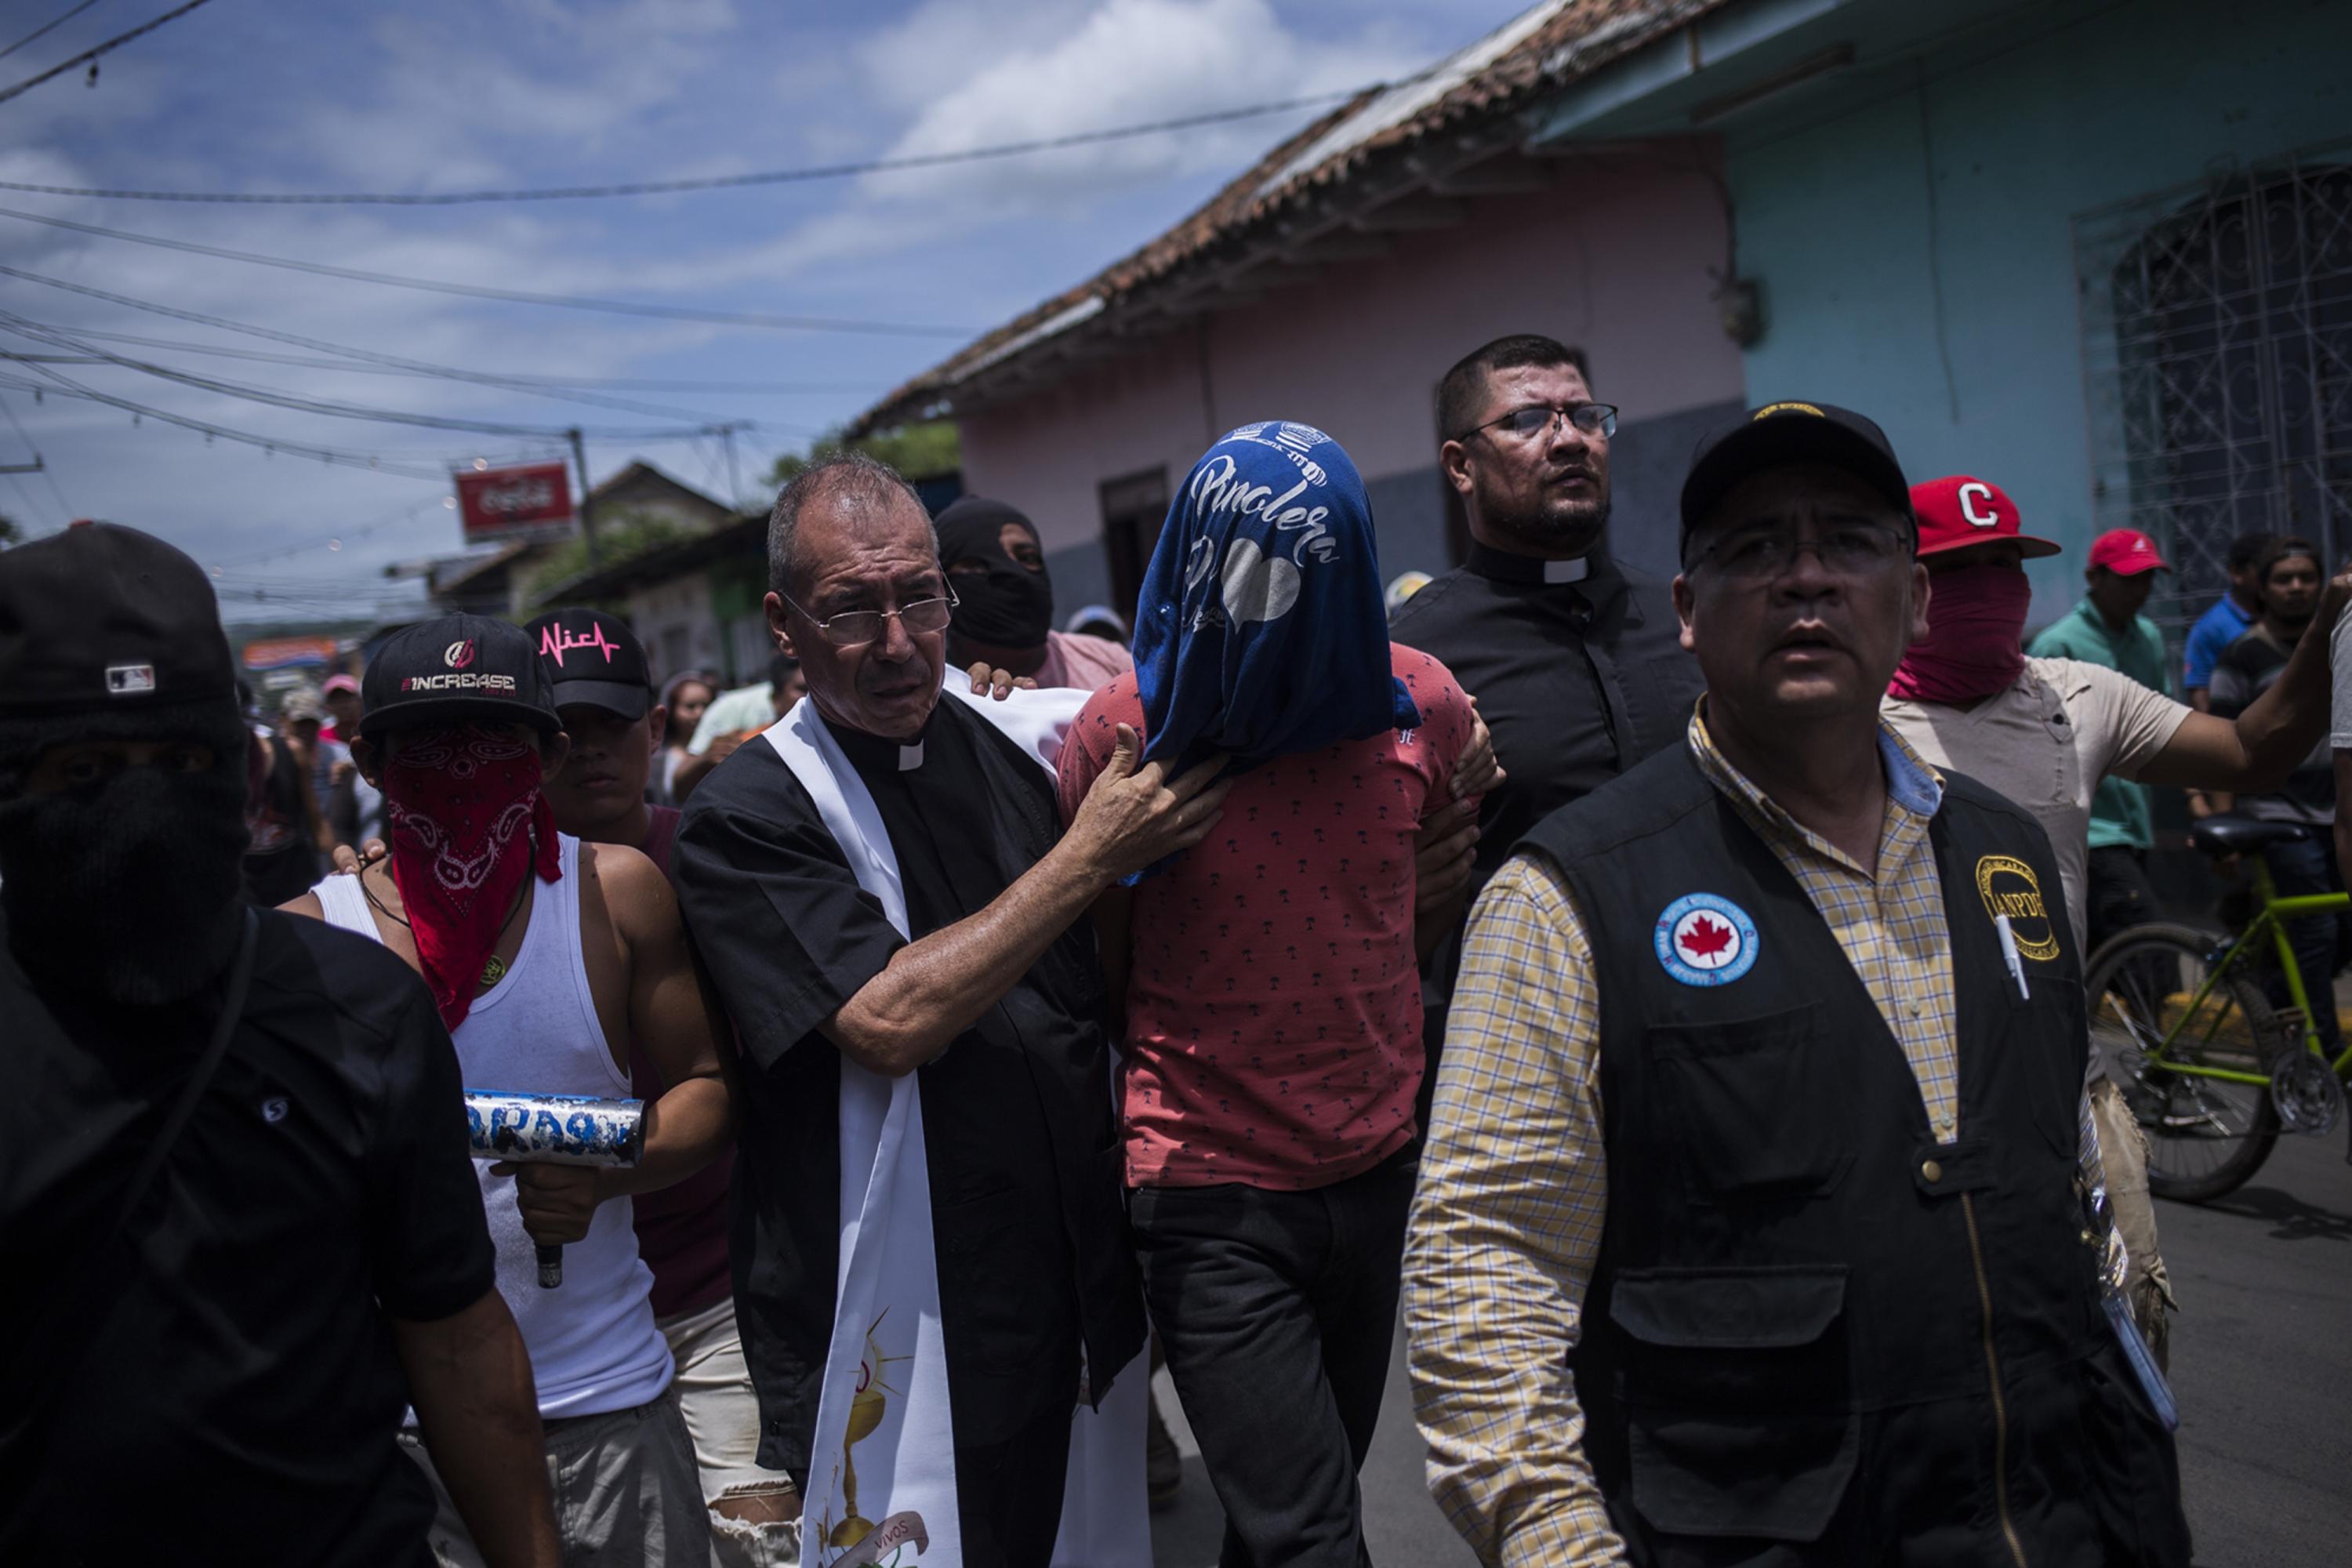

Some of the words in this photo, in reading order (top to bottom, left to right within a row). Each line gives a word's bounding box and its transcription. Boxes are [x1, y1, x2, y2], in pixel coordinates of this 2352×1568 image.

[1191, 455, 1340, 568] Pinolera
[1958, 482, 1998, 527] C
[874, 1519, 908, 1550] VIVOS
